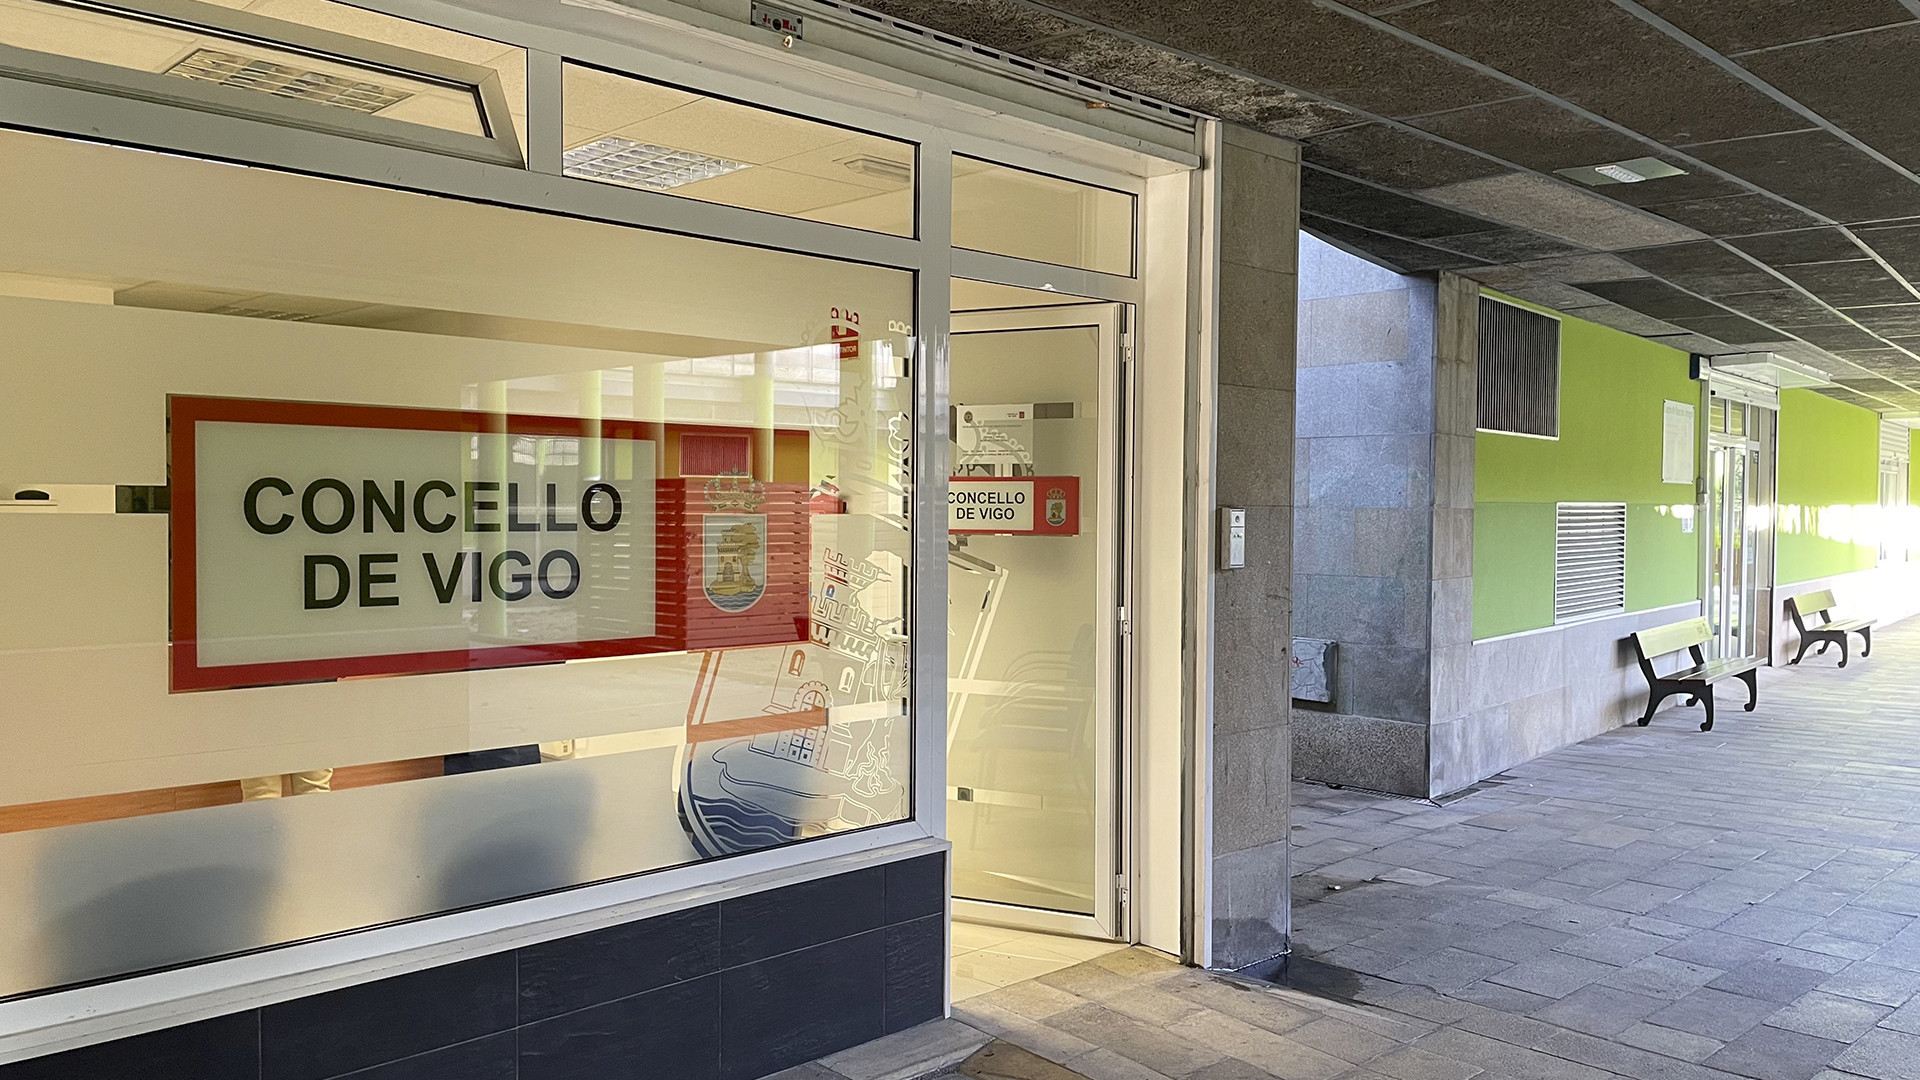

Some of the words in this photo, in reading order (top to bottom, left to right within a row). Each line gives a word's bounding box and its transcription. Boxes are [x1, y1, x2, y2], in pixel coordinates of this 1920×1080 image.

[243, 477, 623, 535] CONCELLO
[948, 492, 1025, 504] CONCELLO
[956, 508, 975, 519] DE
[979, 508, 1015, 520] VIGO
[304, 552, 400, 610] DE
[423, 549, 582, 605] VIGO
